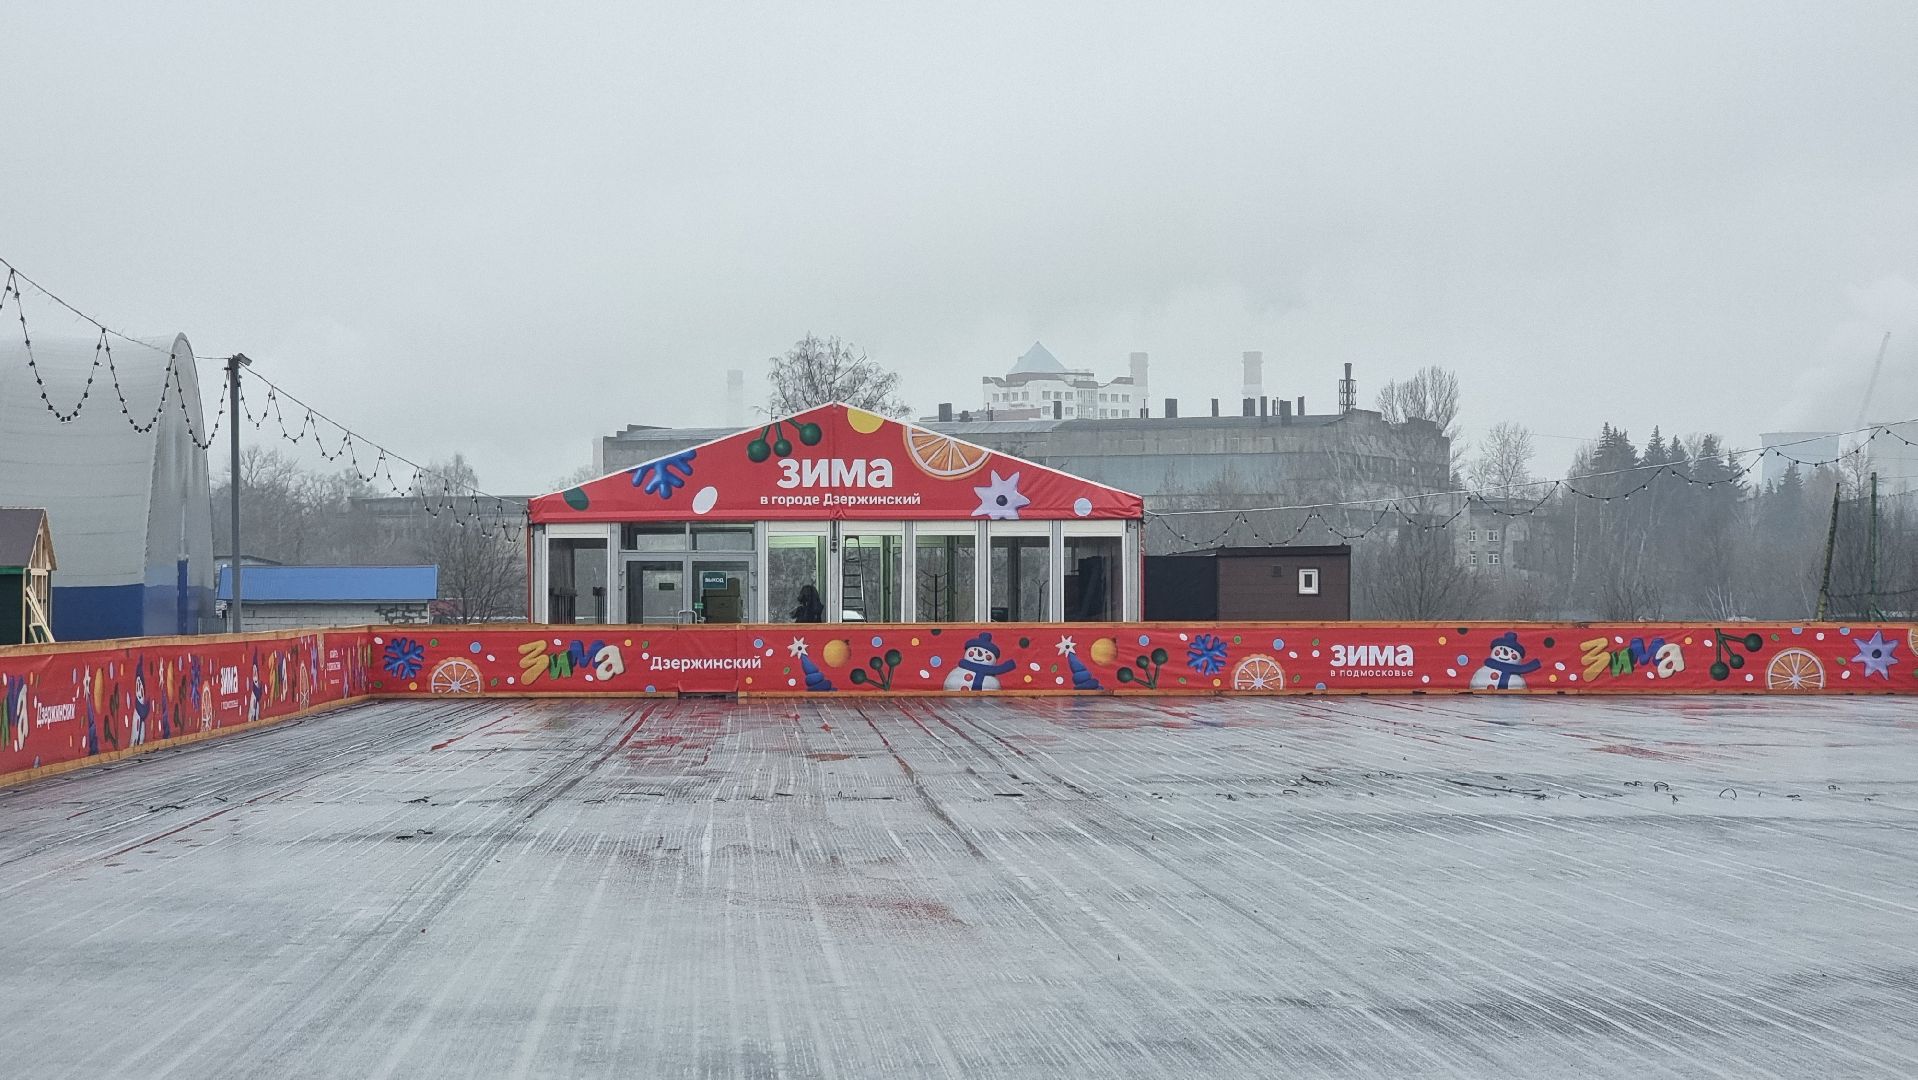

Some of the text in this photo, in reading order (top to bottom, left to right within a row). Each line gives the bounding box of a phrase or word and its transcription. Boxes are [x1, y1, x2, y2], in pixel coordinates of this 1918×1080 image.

[760, 492, 921, 507] в городе Дзержинский
[650, 656, 762, 672] Дзержинский
[1330, 669, 1414, 678] в подмосковье
